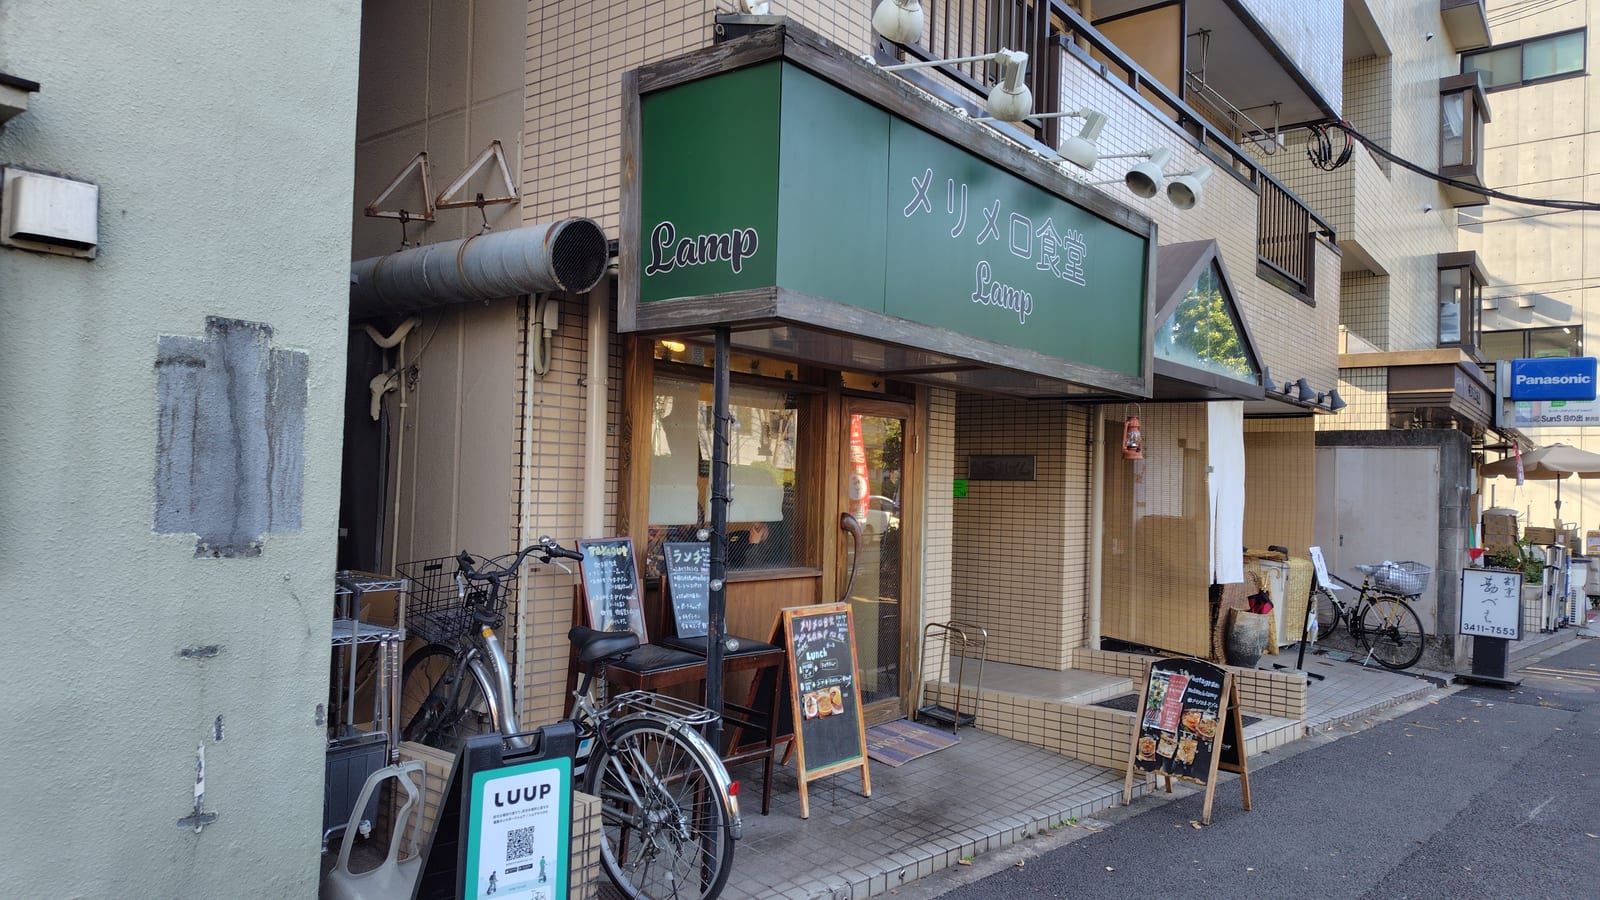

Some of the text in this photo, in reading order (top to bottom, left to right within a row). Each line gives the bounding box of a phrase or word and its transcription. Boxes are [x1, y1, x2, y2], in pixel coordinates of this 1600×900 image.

[904, 168, 1086, 286] メリメロ食堂
[645, 221, 759, 276] Lamp
[972, 261, 1033, 324] Lamp
[1516, 373, 1591, 385] Panasonic
[1463, 622, 1515, 636] 3411-7553
[806, 647, 828, 661] Lunch
[494, 783, 551, 807] LUUP
